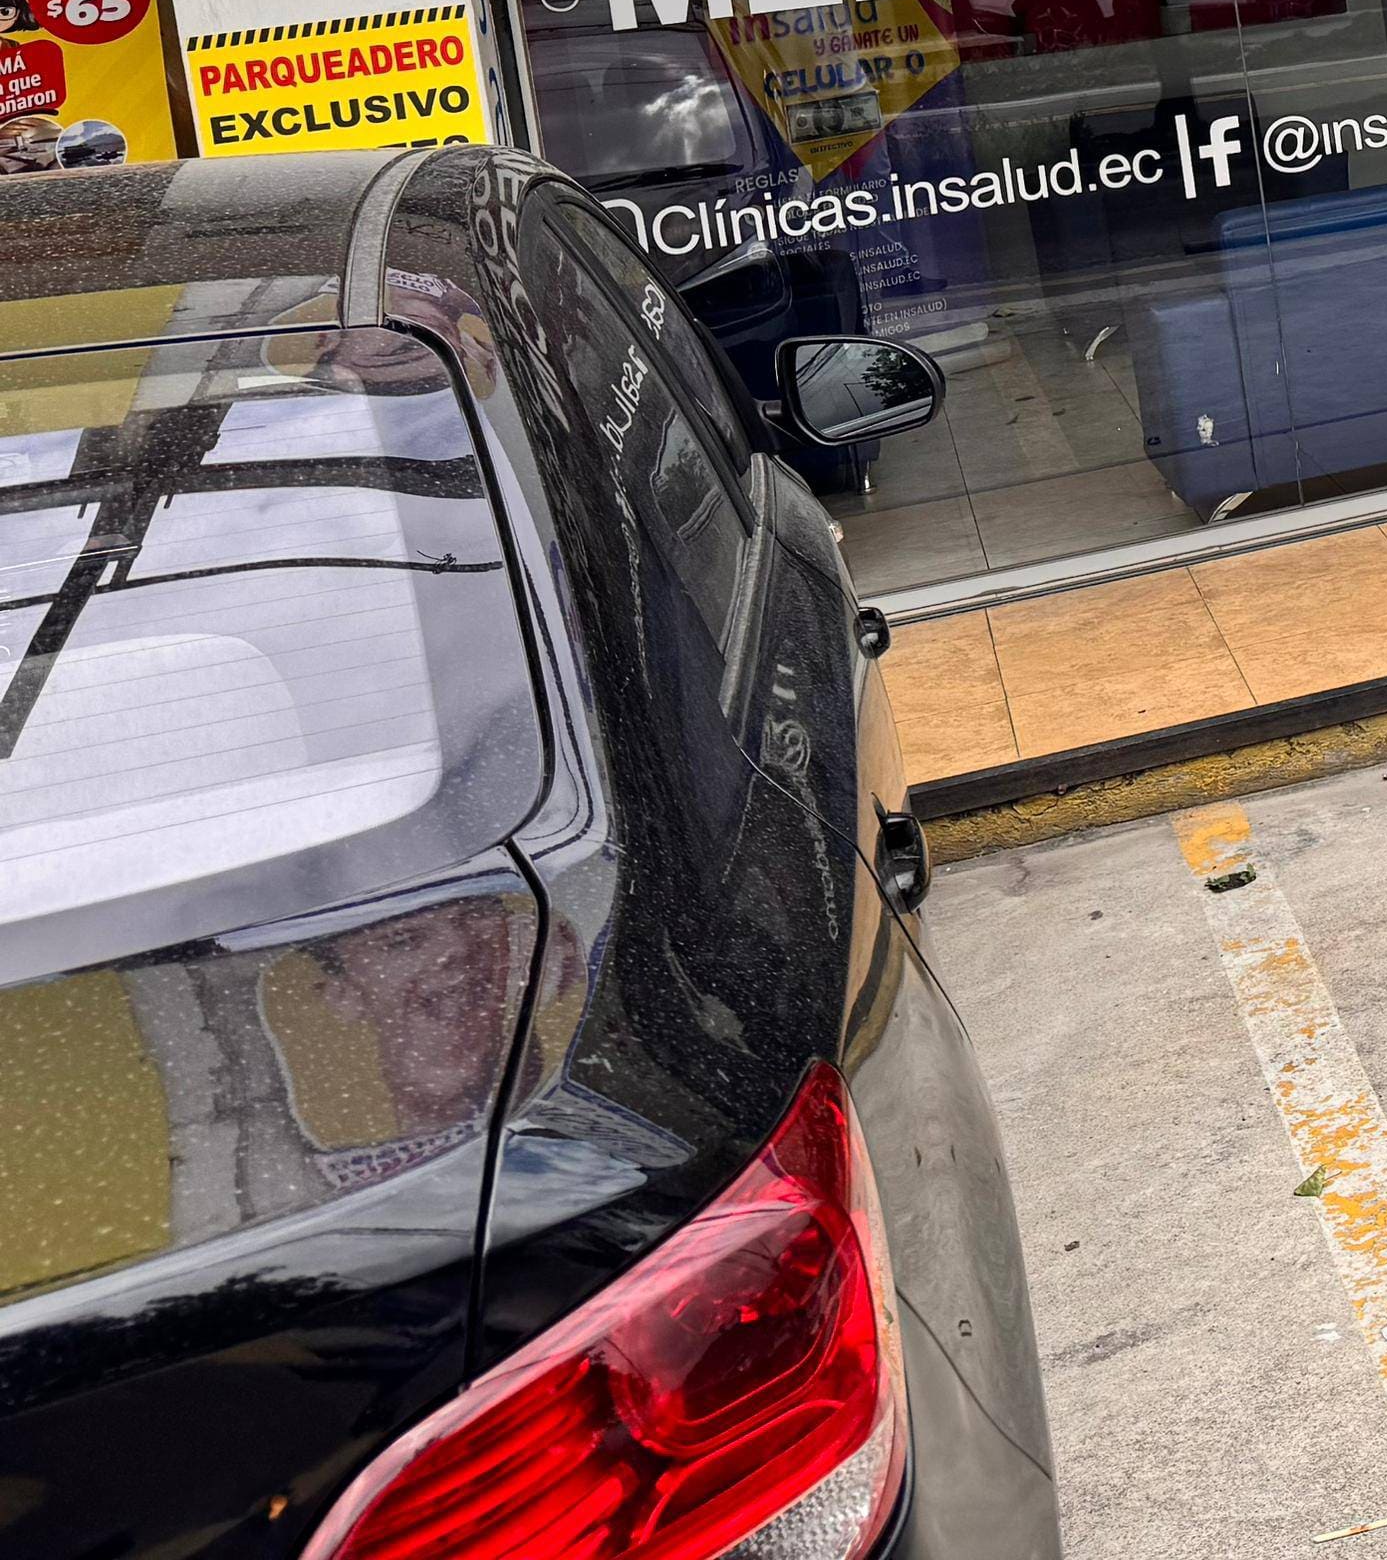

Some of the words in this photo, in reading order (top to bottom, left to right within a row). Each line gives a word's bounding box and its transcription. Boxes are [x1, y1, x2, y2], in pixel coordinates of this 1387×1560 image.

[895, 24, 920, 44] UN
[9, 73, 42, 96] que
[199, 35, 465, 97] PARQUEADERO
[763, 55, 895, 101] CELULAR
[210, 85, 471, 144] EXCLUSIVO
[650, 147, 1163, 256] Clínicas.insalud.ec
[735, 167, 800, 194] REGLAS
